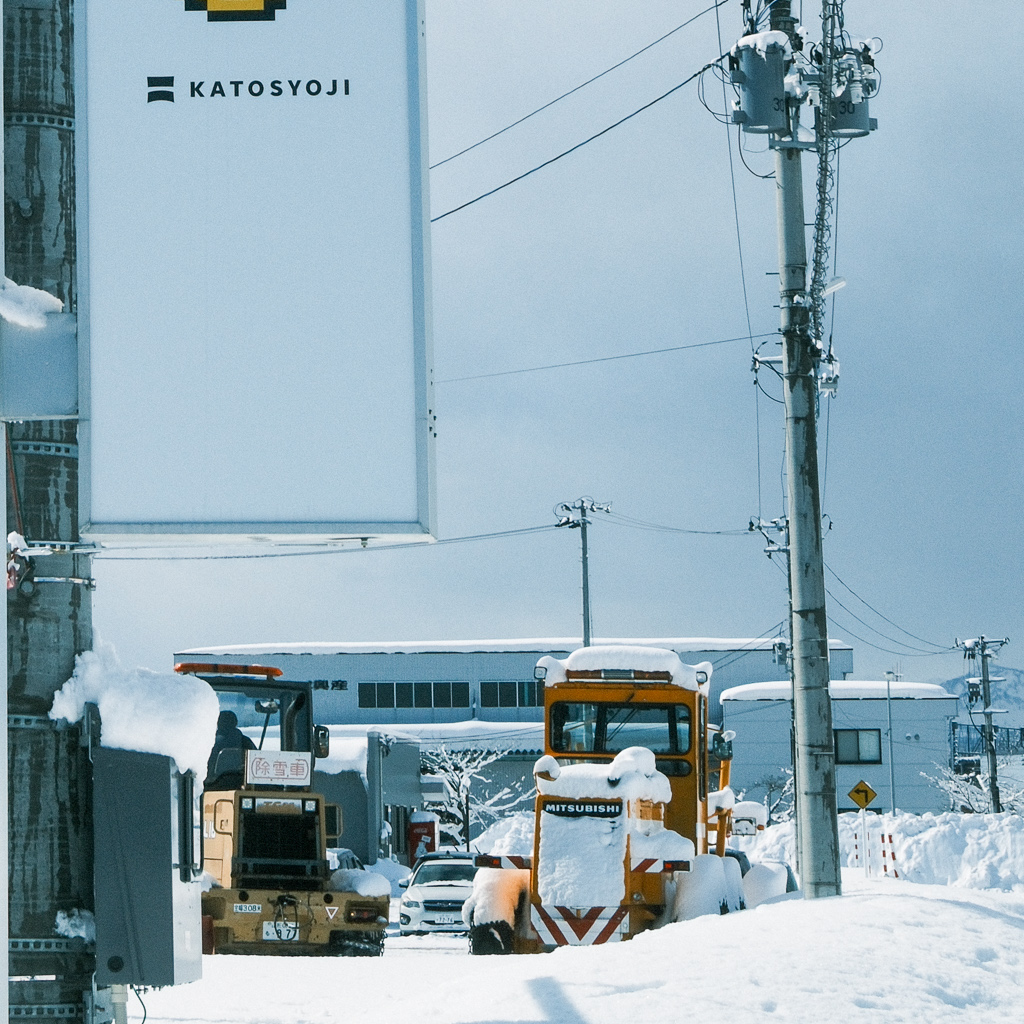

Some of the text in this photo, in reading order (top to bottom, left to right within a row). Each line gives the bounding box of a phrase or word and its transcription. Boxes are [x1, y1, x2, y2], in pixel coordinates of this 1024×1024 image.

[189, 79, 350, 97] KATOSYOJI
[839, 100, 856, 115] 30
[255, 760, 305, 777] 除雪車
[545, 803, 619, 813] MITSUBISHI
